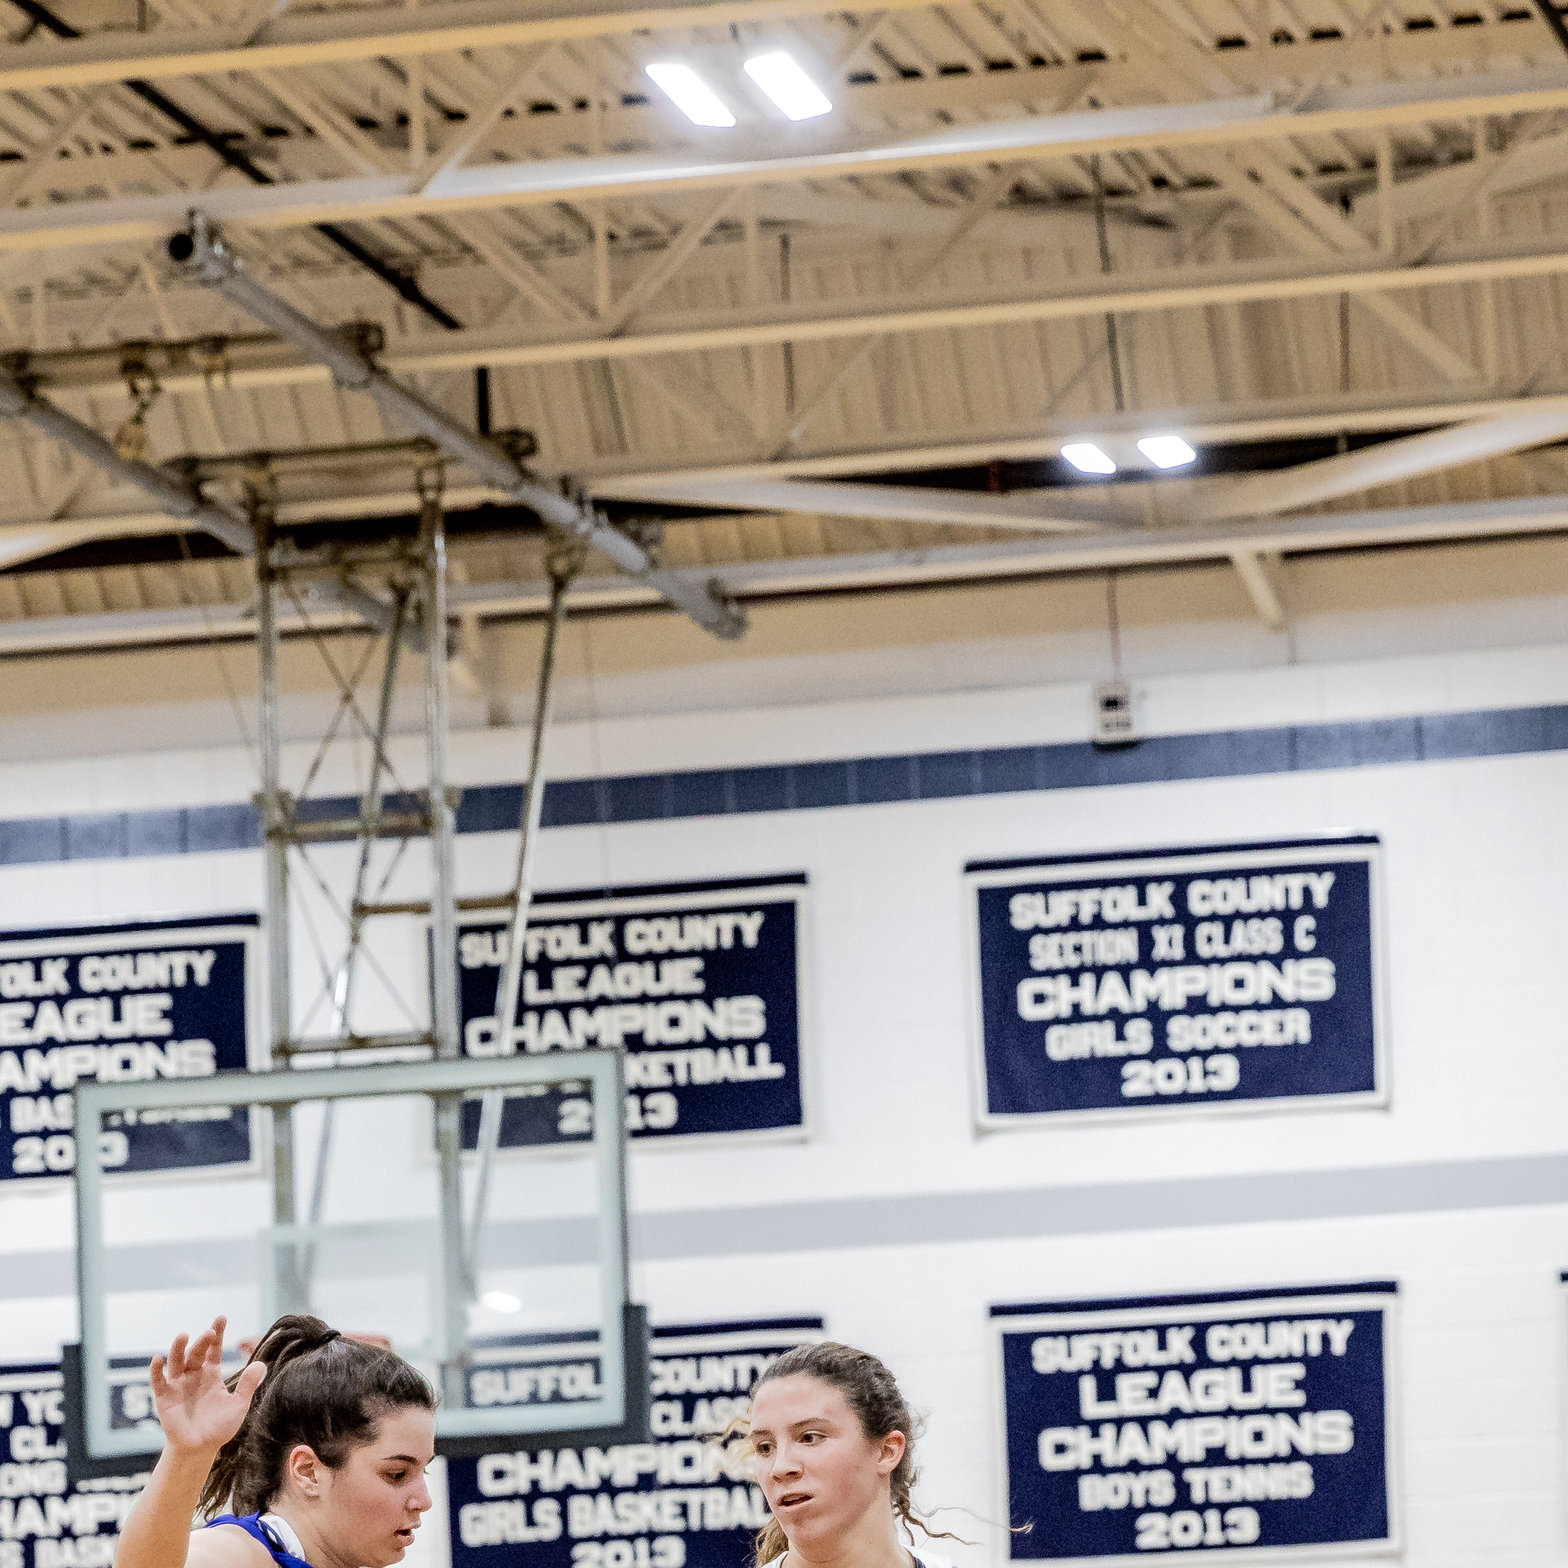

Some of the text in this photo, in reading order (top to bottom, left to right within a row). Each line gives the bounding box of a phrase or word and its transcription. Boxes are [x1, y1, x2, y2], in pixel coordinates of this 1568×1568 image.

[1009, 873, 1336, 930] SUFFOLK COUNTY
[459, 912, 764, 969] SUFOLK COUNTY
[1029, 915, 1317, 970] SECTION XI CLASS C
[78, 950, 216, 994] COUNTY
[523, 958, 706, 1004] LEAGUE
[1016, 957, 1337, 1020] CHAMPIONS
[464, 995, 767, 1058] CHAMPIONS
[1045, 1009, 1312, 1061] GIRLS SOCCER
[1120, 1053, 1241, 1099] 2013
[557, 1091, 679, 1135] 213
[1031, 1319, 1355, 1374] SUFFOLK COUNTY
[469, 1364, 603, 1407] SUFFOL
[1079, 1364, 1306, 1420] LEAGUE
[1039, 1409, 1354, 1471] CHAMPIONS
[1078, 1461, 1314, 1511] BOYS TENNIS
[459, 1485, 773, 1548] GIRLS BASKETBAL
[1136, 1507, 1259, 1549] 2013
